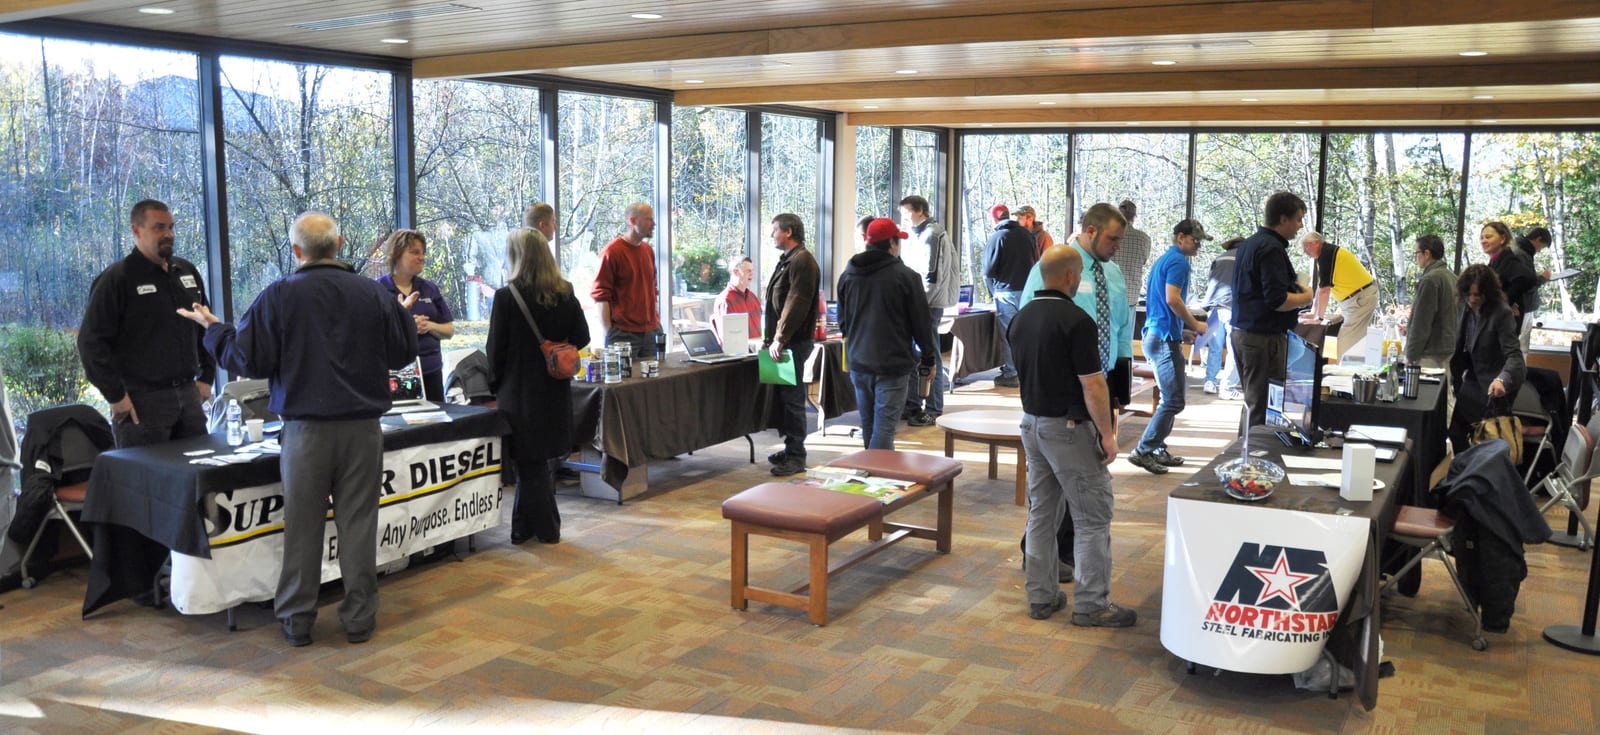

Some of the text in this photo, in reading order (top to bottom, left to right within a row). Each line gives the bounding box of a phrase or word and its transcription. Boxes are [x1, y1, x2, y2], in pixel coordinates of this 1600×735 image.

[409, 442, 500, 490] DIESEL
[380, 522, 407, 548] Any
[408, 507, 451, 539] Purpose.
[455, 491, 493, 522] Endless
[1201, 620, 1238, 637] STEEL
[1241, 627, 1320, 644] FABRICATING
[1204, 602, 1338, 633] NORTHSTAR
